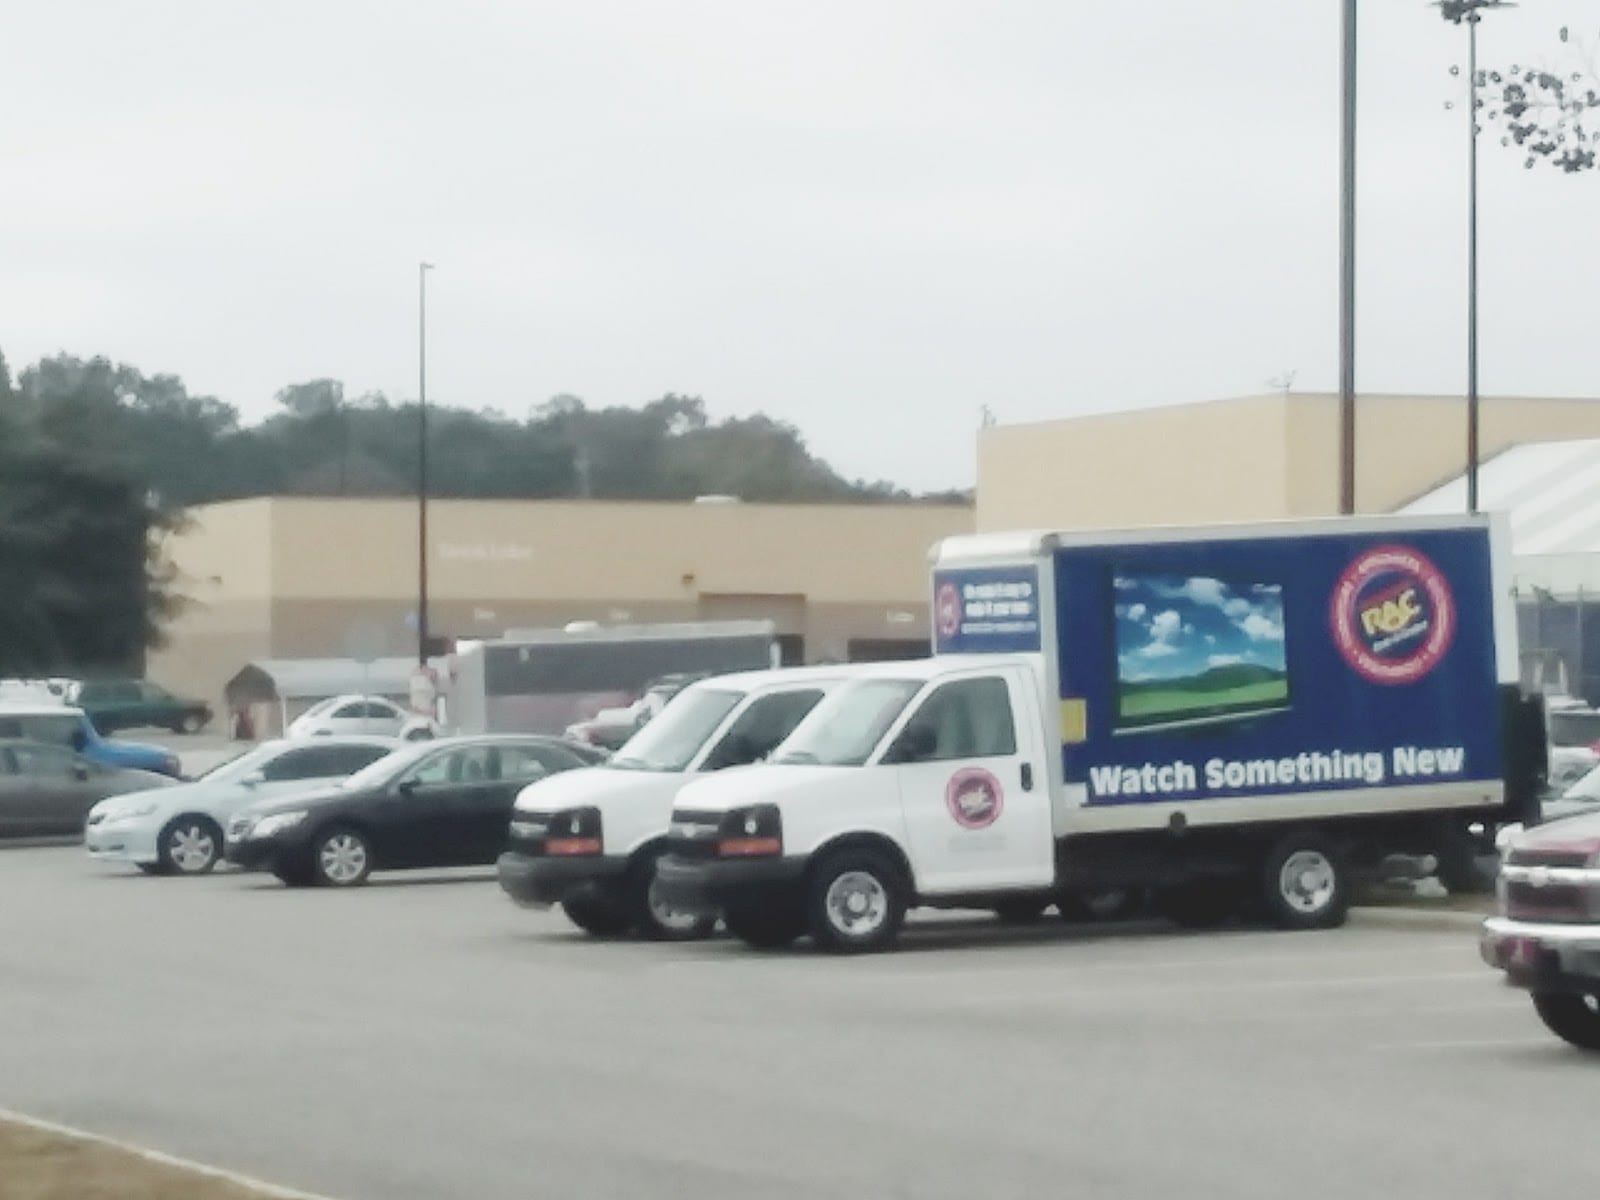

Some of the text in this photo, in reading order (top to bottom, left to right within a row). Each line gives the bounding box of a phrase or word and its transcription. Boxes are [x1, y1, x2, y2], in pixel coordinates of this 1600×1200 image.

[1089, 746, 1465, 796] Watch Something New
